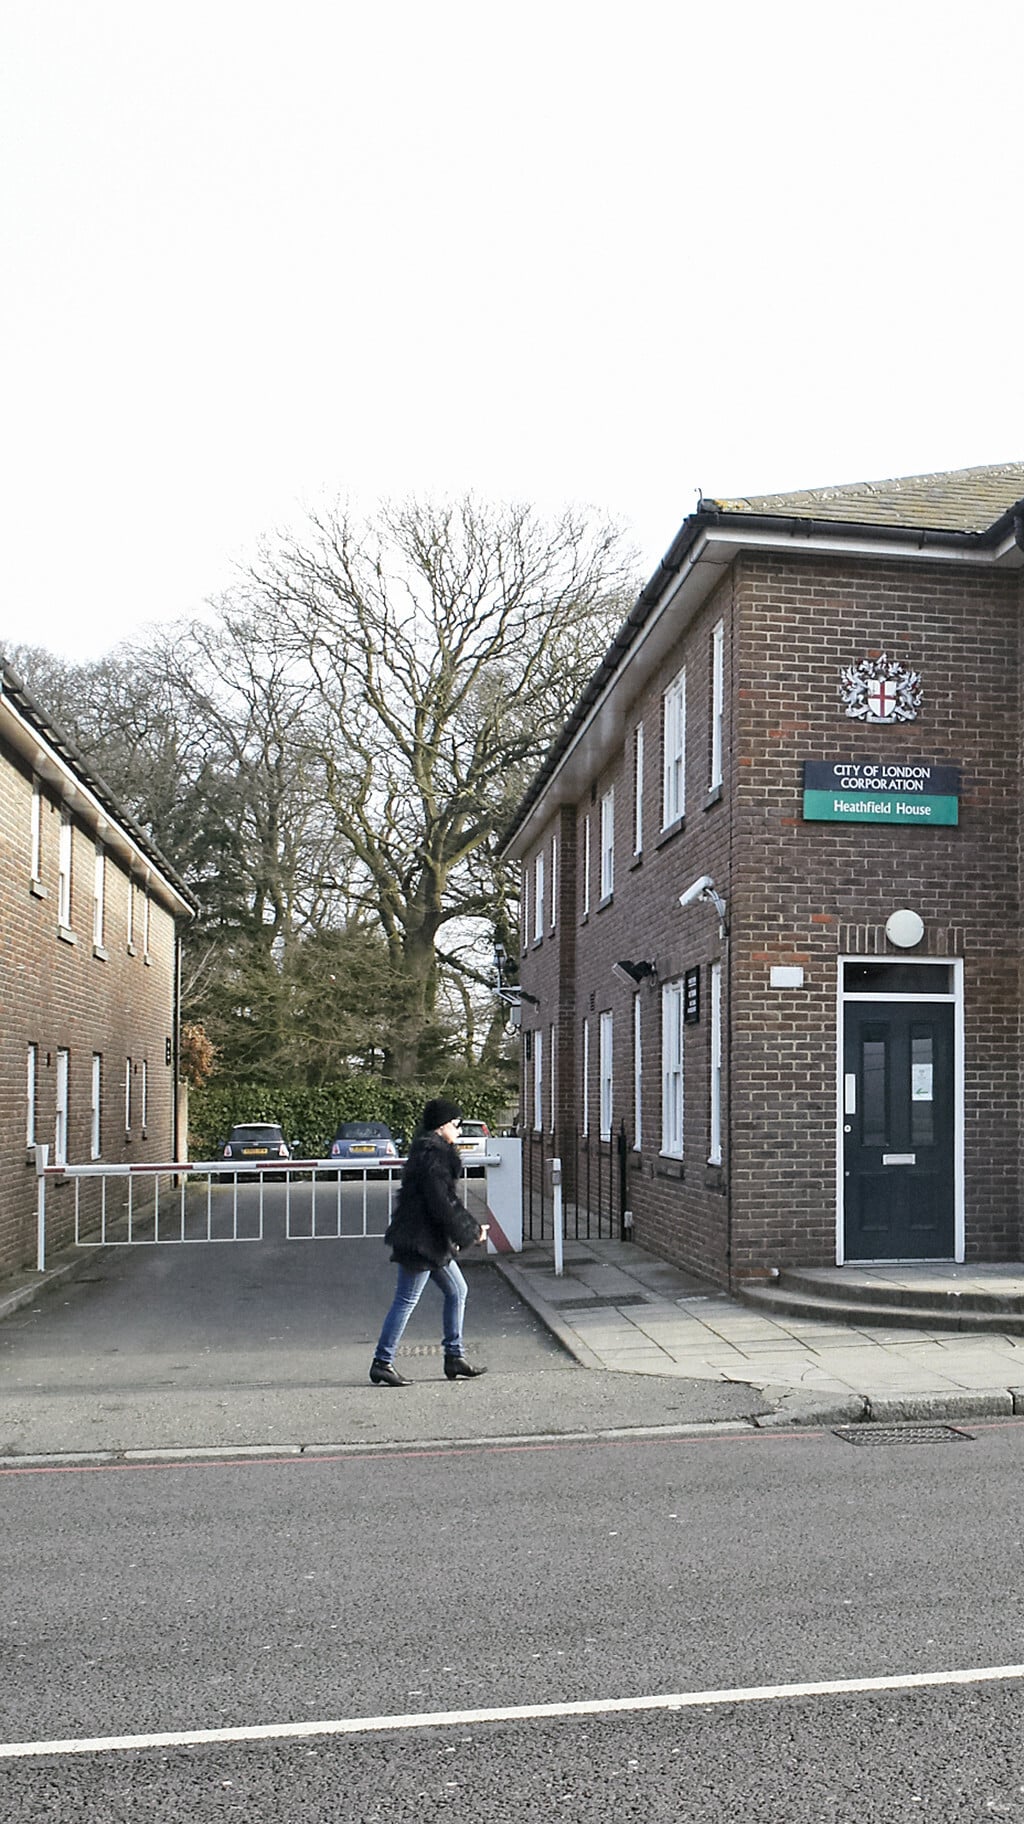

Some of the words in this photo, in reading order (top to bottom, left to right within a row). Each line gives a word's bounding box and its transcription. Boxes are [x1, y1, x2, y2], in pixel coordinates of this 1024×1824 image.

[833, 764, 861, 776] CITY
[863, 765, 879, 777] OF
[882, 766, 931, 778] LONDON
[840, 777, 924, 791] CORPORATION
[833, 800, 891, 814] Heathfield
[896, 802, 932, 816] House
